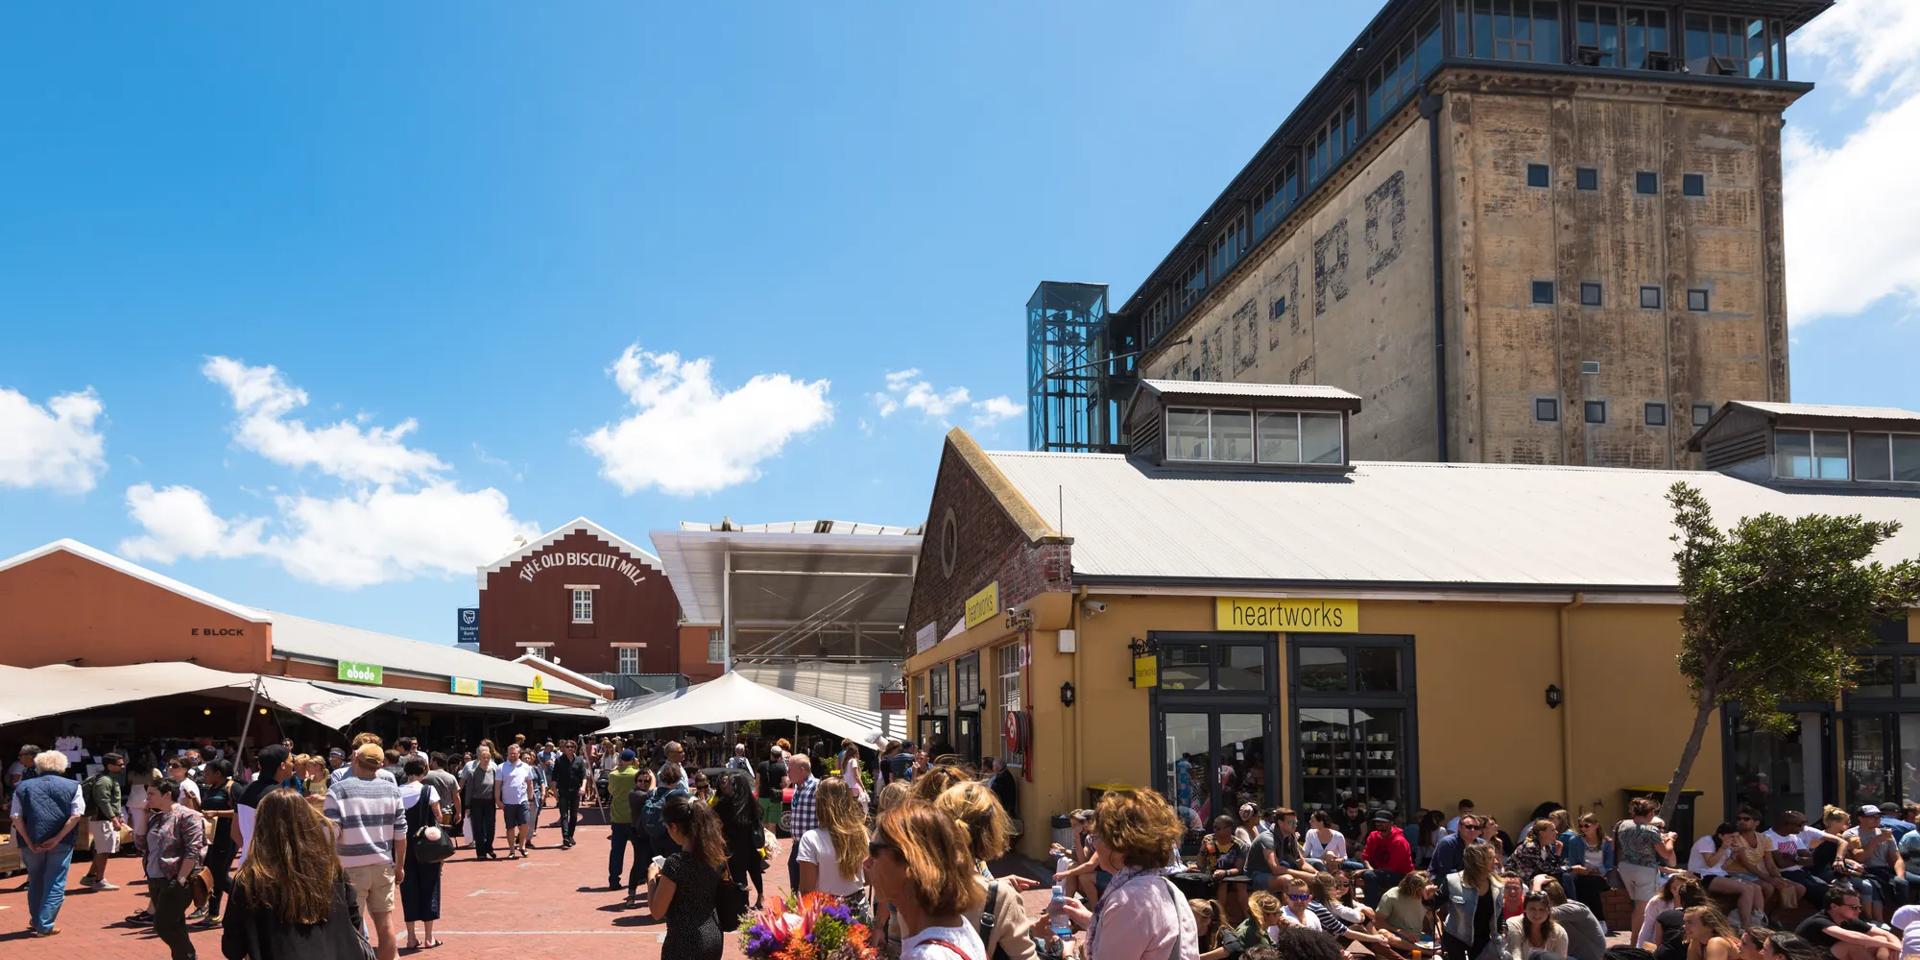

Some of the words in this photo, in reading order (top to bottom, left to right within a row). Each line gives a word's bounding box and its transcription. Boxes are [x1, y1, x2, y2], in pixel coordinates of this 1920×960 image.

[519, 559, 542, 582] THE
[541, 552, 564, 568] OLD
[566, 552, 619, 569] BISCUIT
[617, 559, 646, 586] MILL
[1232, 599, 1343, 627] heartworks
[191, 628, 200, 636] E
[203, 628, 244, 636] BLOCK
[346, 664, 375, 681] abode
